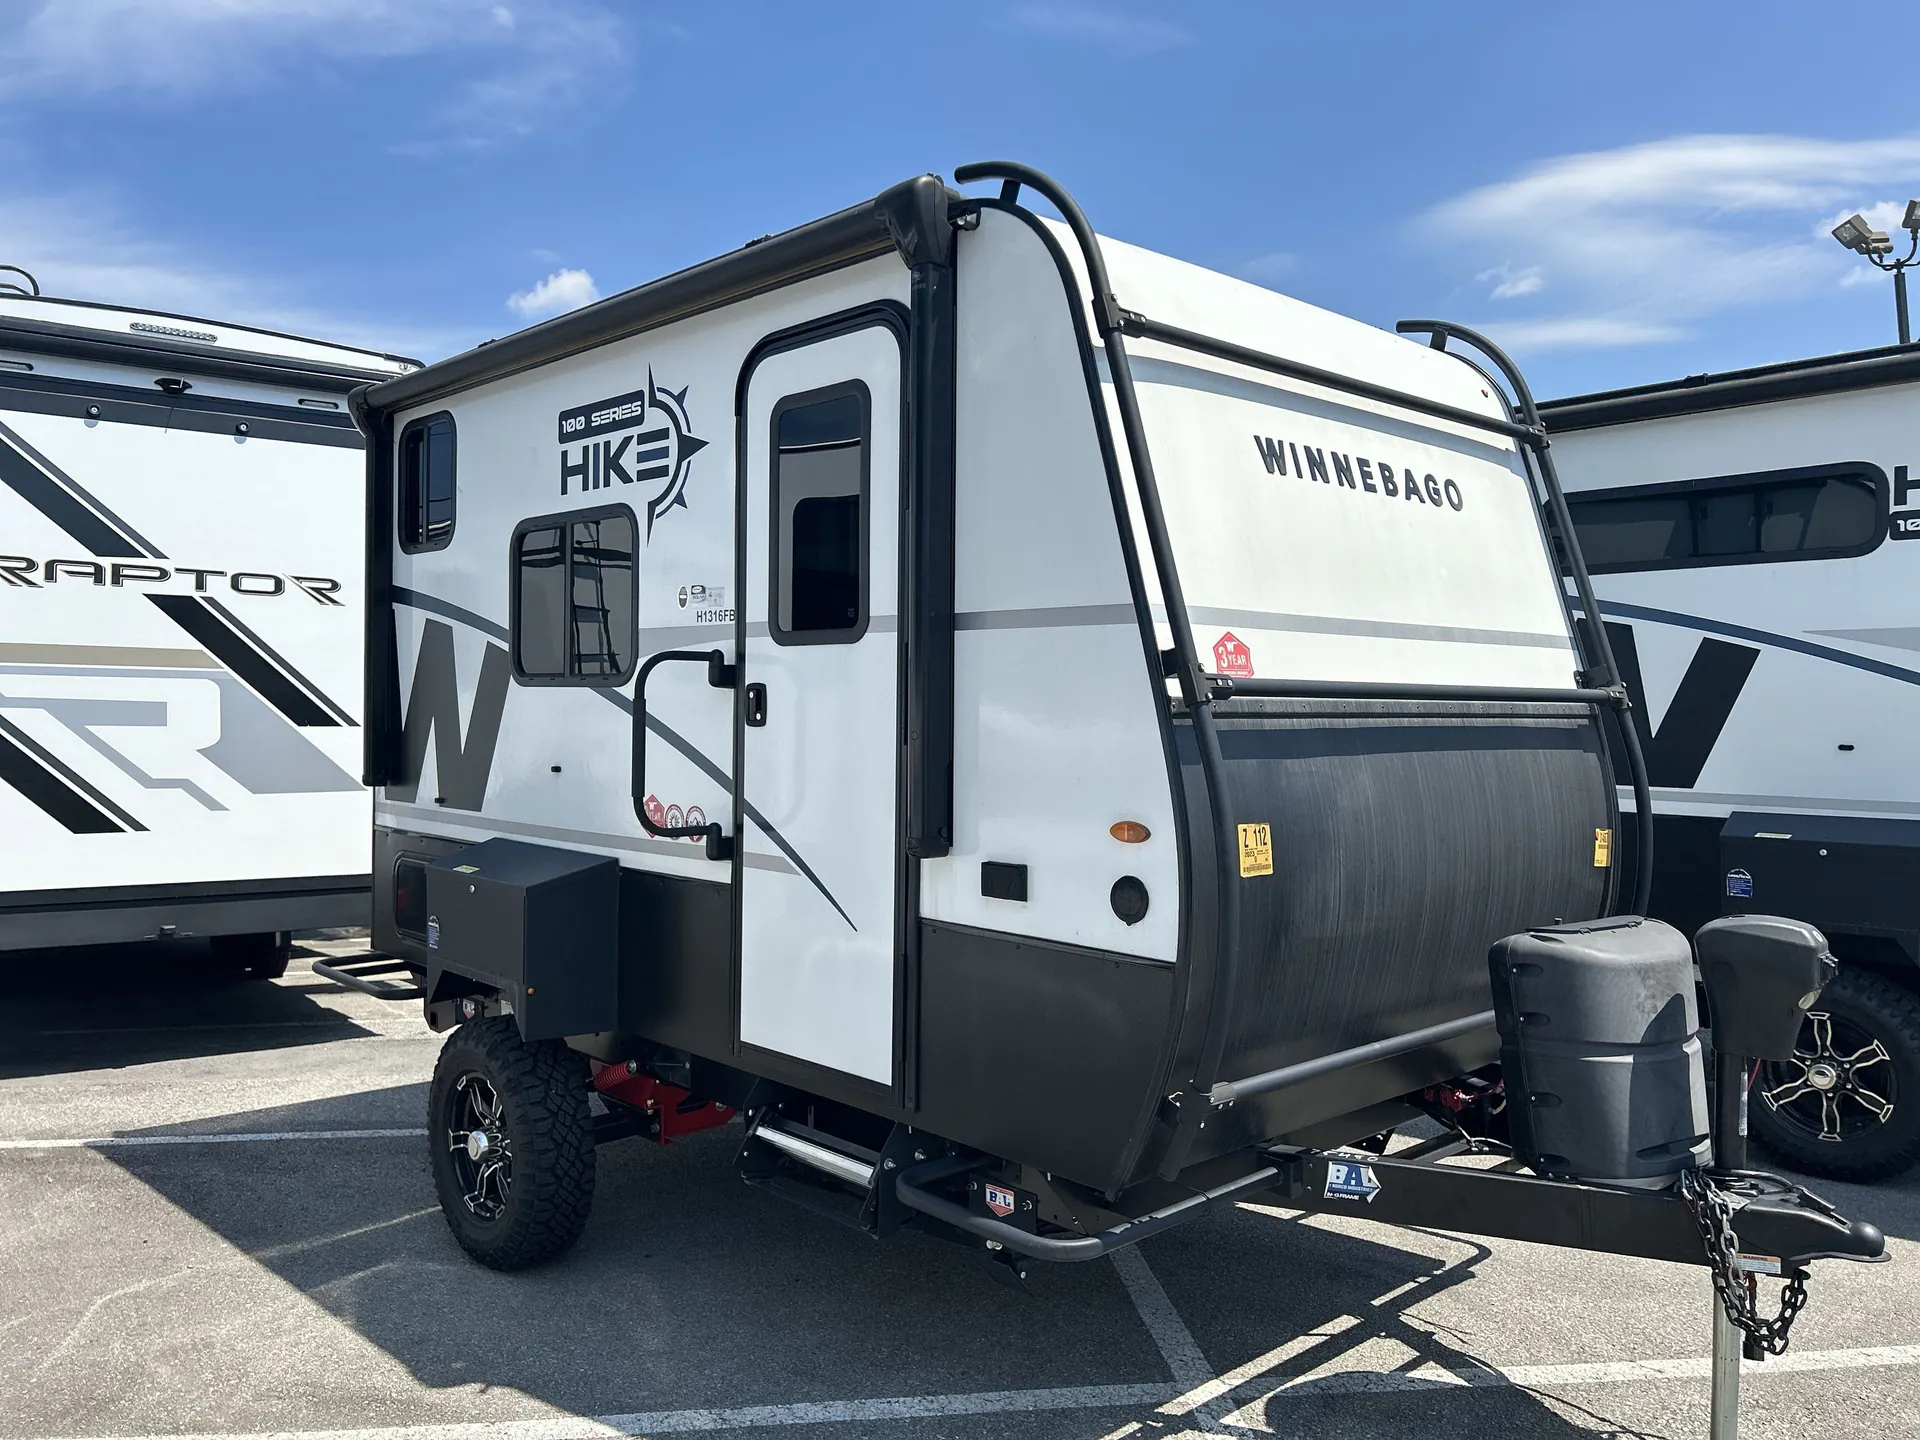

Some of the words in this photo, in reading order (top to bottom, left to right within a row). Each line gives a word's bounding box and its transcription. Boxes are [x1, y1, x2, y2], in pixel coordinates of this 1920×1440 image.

[562, 416, 585, 433] 100
[591, 401, 642, 426] SERIES
[561, 427, 670, 496] HIKE
[1253, 435, 1463, 511] WINNEBAGO
[0, 555, 345, 607] RAPTOR
[696, 609, 736, 623] H1316FB
[1218, 646, 1228, 668] 3
[1227, 654, 1247, 666] YEAR
[1253, 826, 1267, 846] 112
